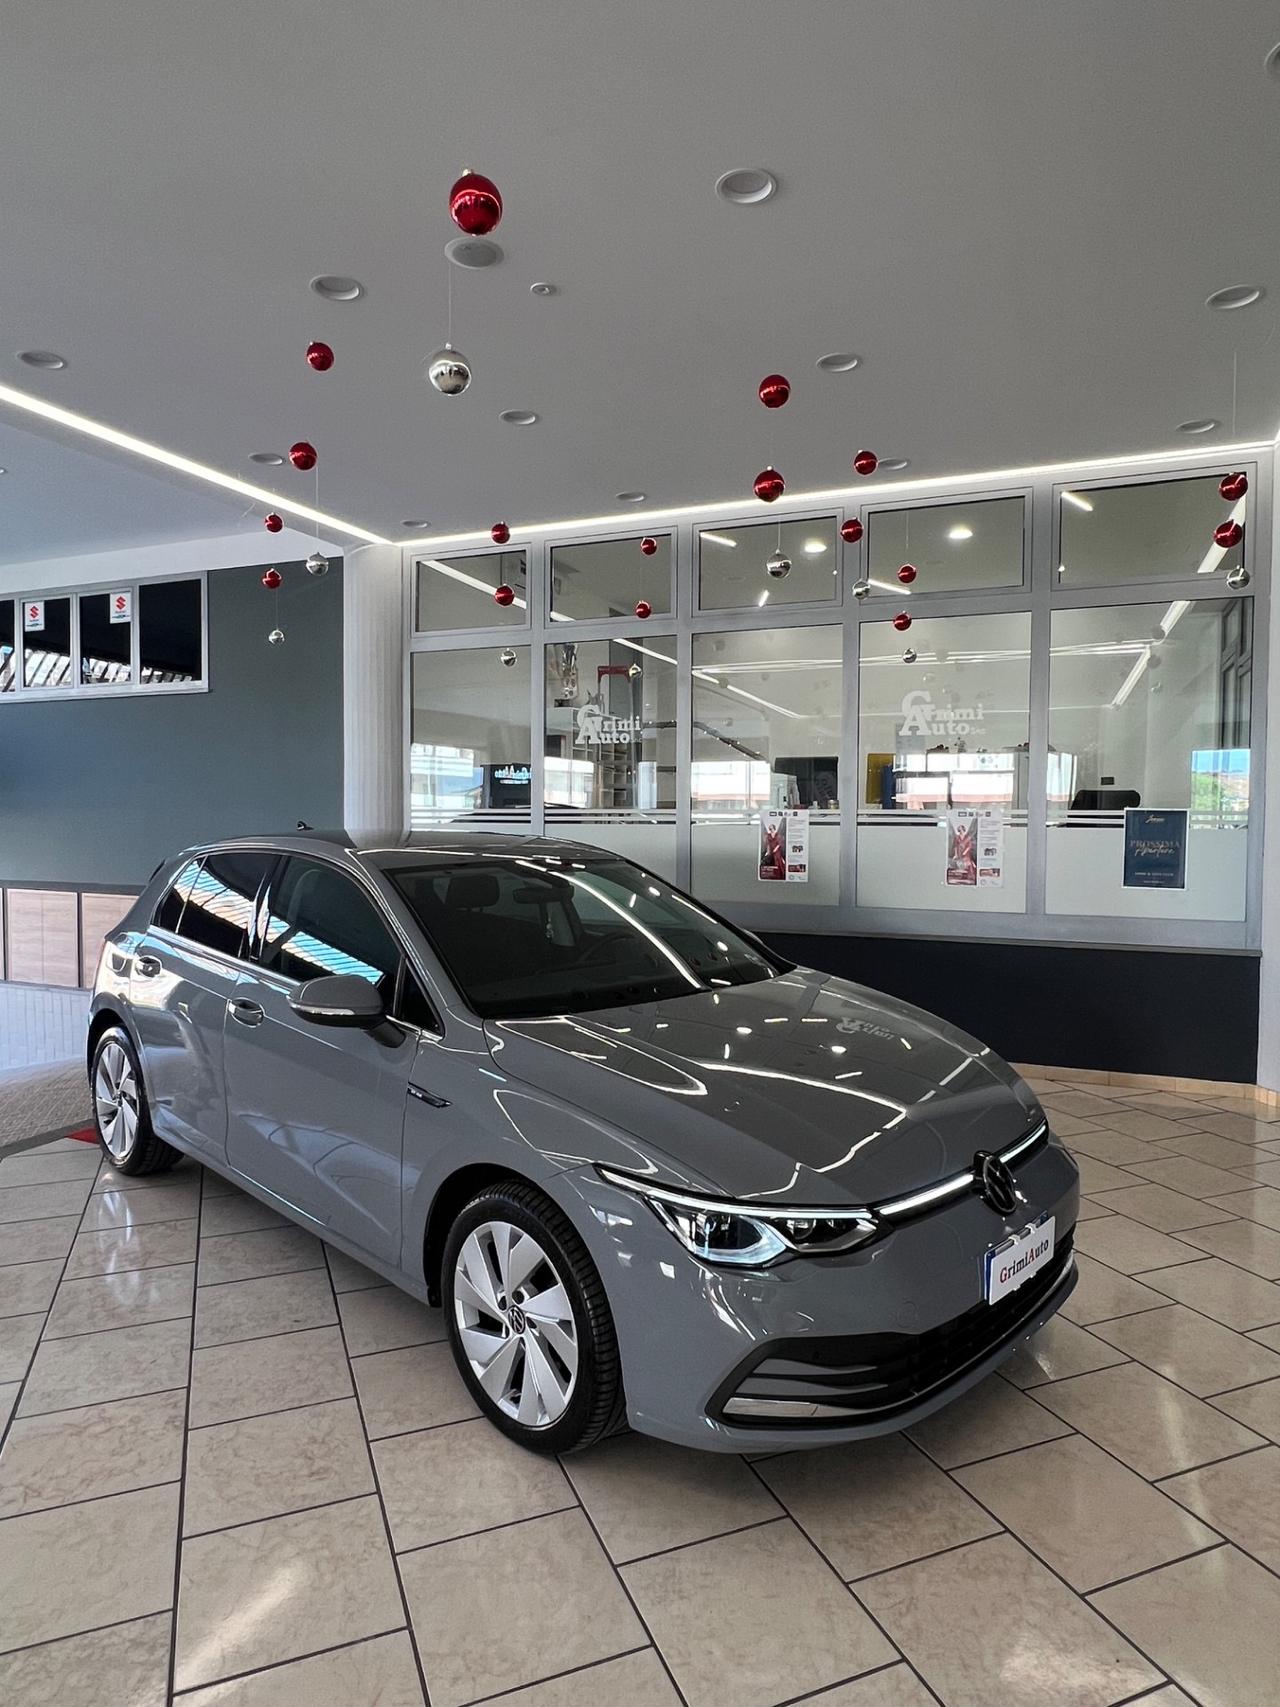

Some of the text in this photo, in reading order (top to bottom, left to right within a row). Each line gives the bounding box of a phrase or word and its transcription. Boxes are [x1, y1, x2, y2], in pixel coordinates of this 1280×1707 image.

[577, 704, 640, 731] Grimi
[899, 704, 970, 736] Auto
[902, 690, 984, 721] Grimi
[575, 716, 631, 744] Auto
[999, 1239, 1049, 1283] GrimiAuto
